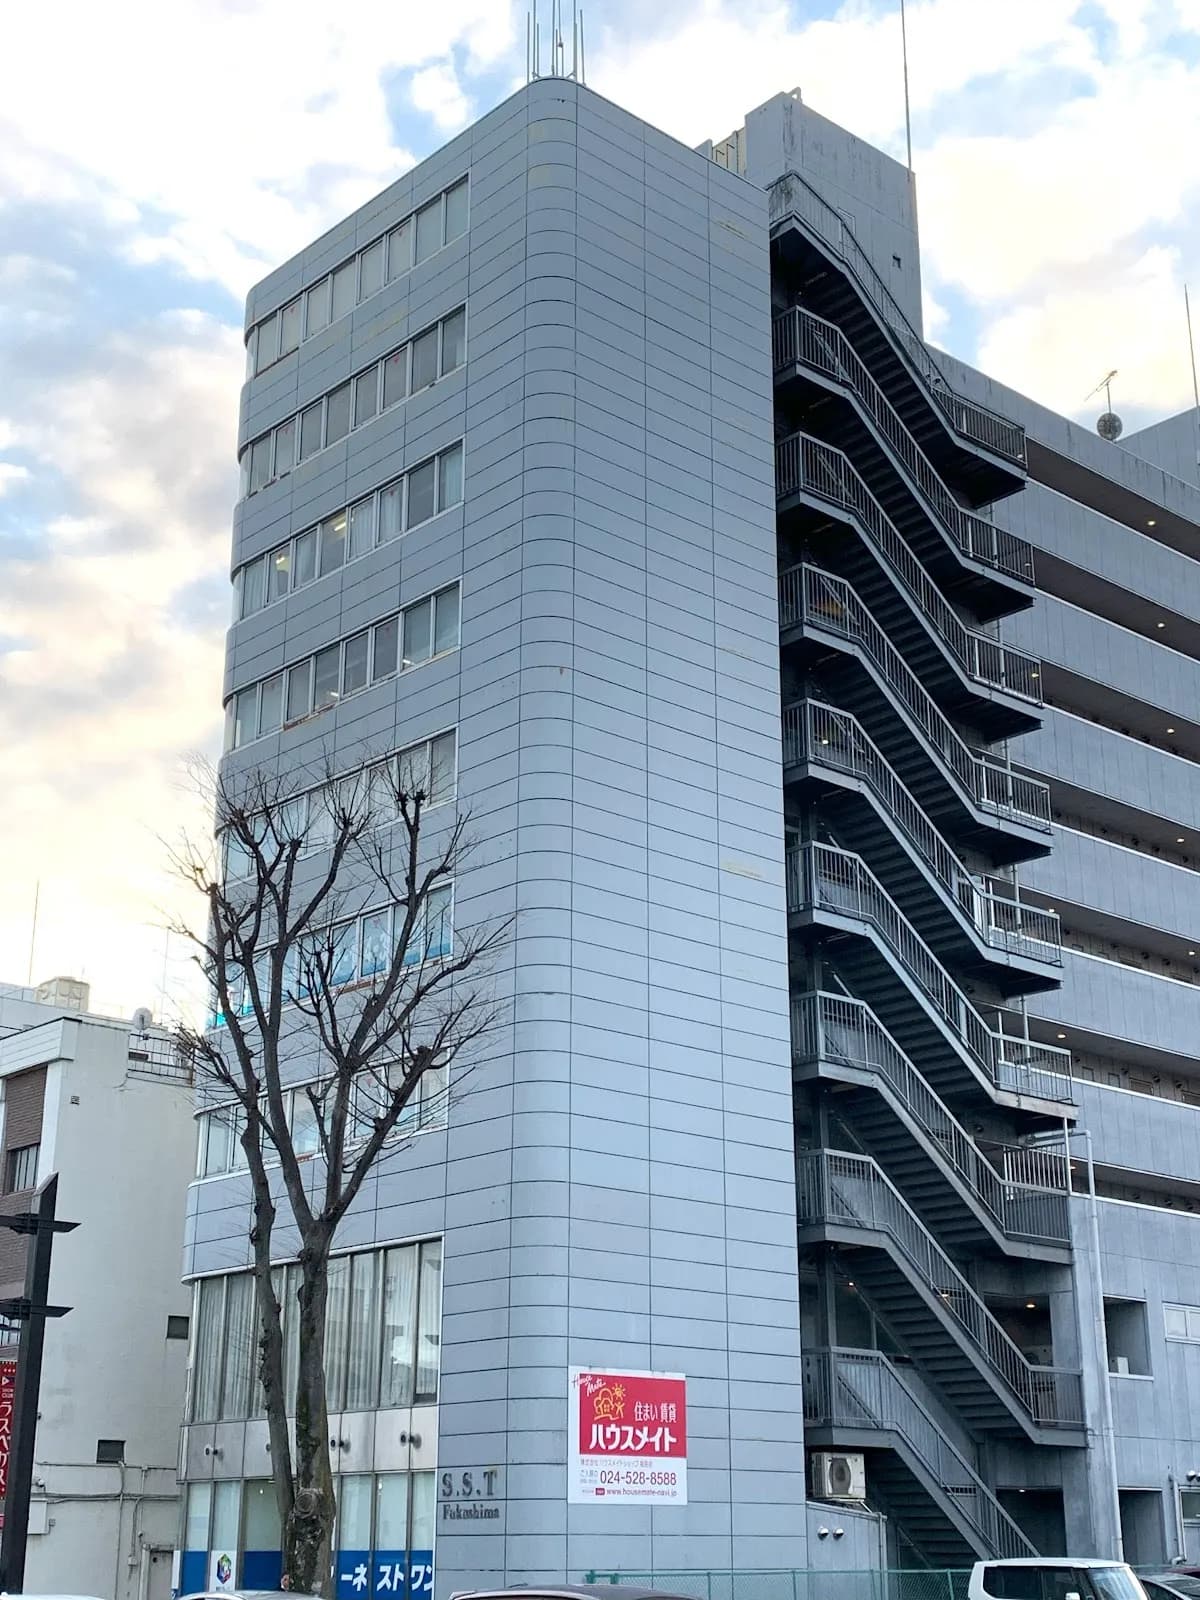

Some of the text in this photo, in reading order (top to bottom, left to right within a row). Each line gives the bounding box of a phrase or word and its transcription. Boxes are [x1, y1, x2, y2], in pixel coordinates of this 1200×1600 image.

[589, 1423, 677, 1452] ハウスメイト
[442, 1470, 497, 1497] S.S.T
[600, 1470, 677, 1486] 024-528-8588
[330, 1563, 433, 1592] ーネストワン
